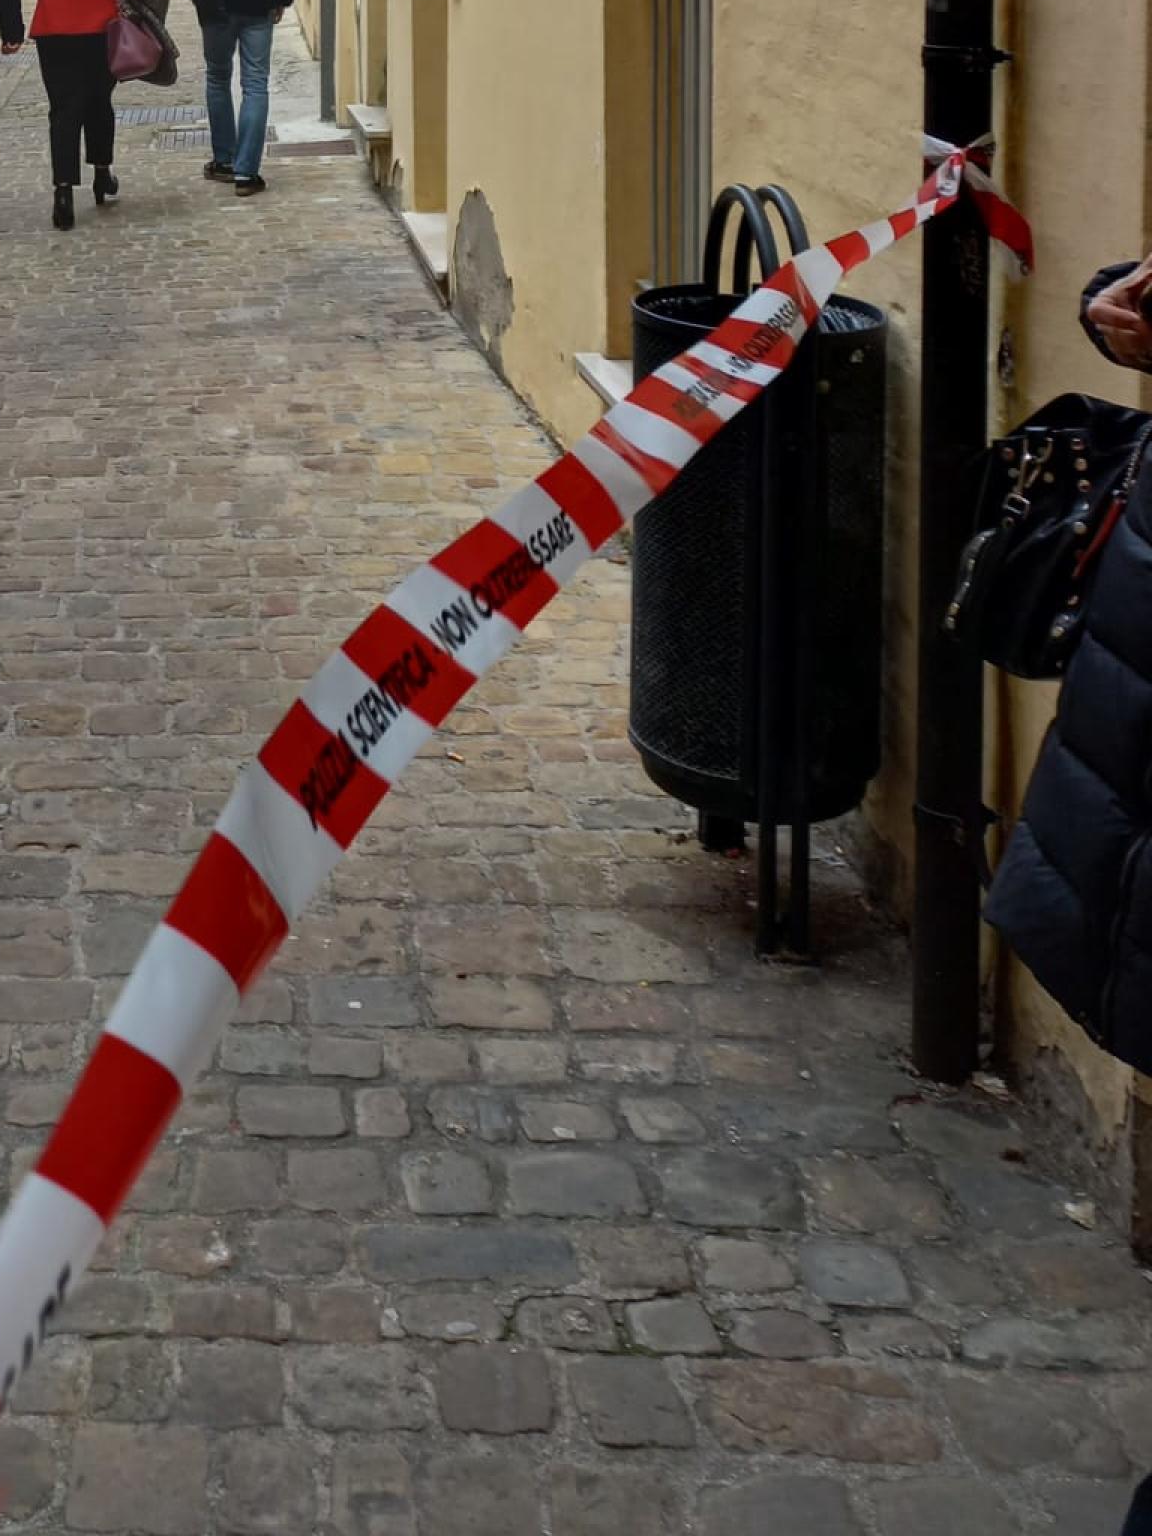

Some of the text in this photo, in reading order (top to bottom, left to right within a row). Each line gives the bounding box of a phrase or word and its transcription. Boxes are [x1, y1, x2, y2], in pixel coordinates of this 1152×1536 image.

[347, 641, 438, 757] SCIENTIFICA
[430, 595, 479, 652] NON
[470, 511, 575, 619] OLTREPASSARE
